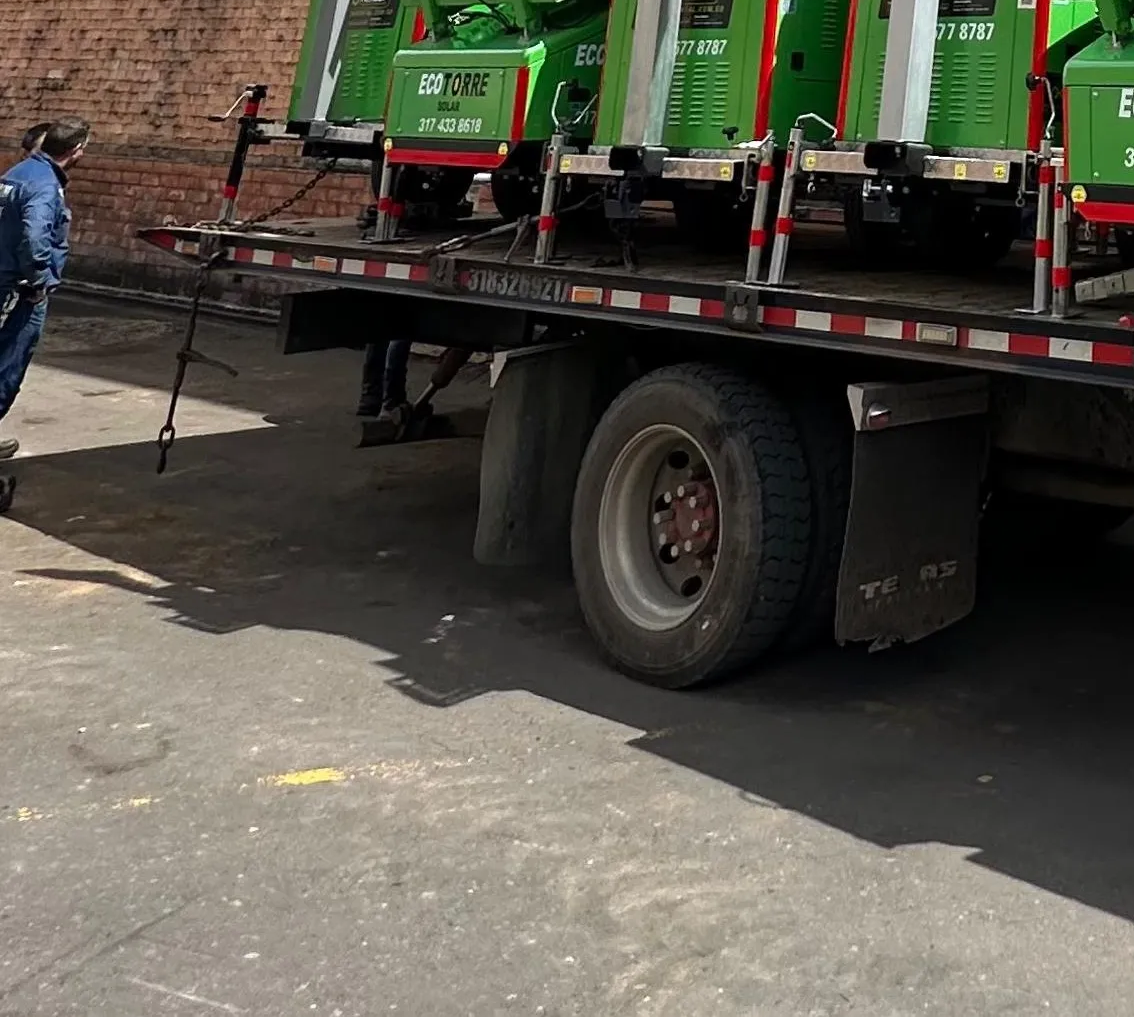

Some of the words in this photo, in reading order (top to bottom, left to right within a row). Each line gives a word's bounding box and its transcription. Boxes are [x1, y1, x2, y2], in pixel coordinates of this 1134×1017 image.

[959, 23, 995, 41] 8787
[697, 39, 728, 56] 8787
[418, 72, 490, 97] ECOTORRE
[418, 117, 437, 132] 317
[437, 117, 456, 133] 433
[457, 117, 482, 133] 8618
